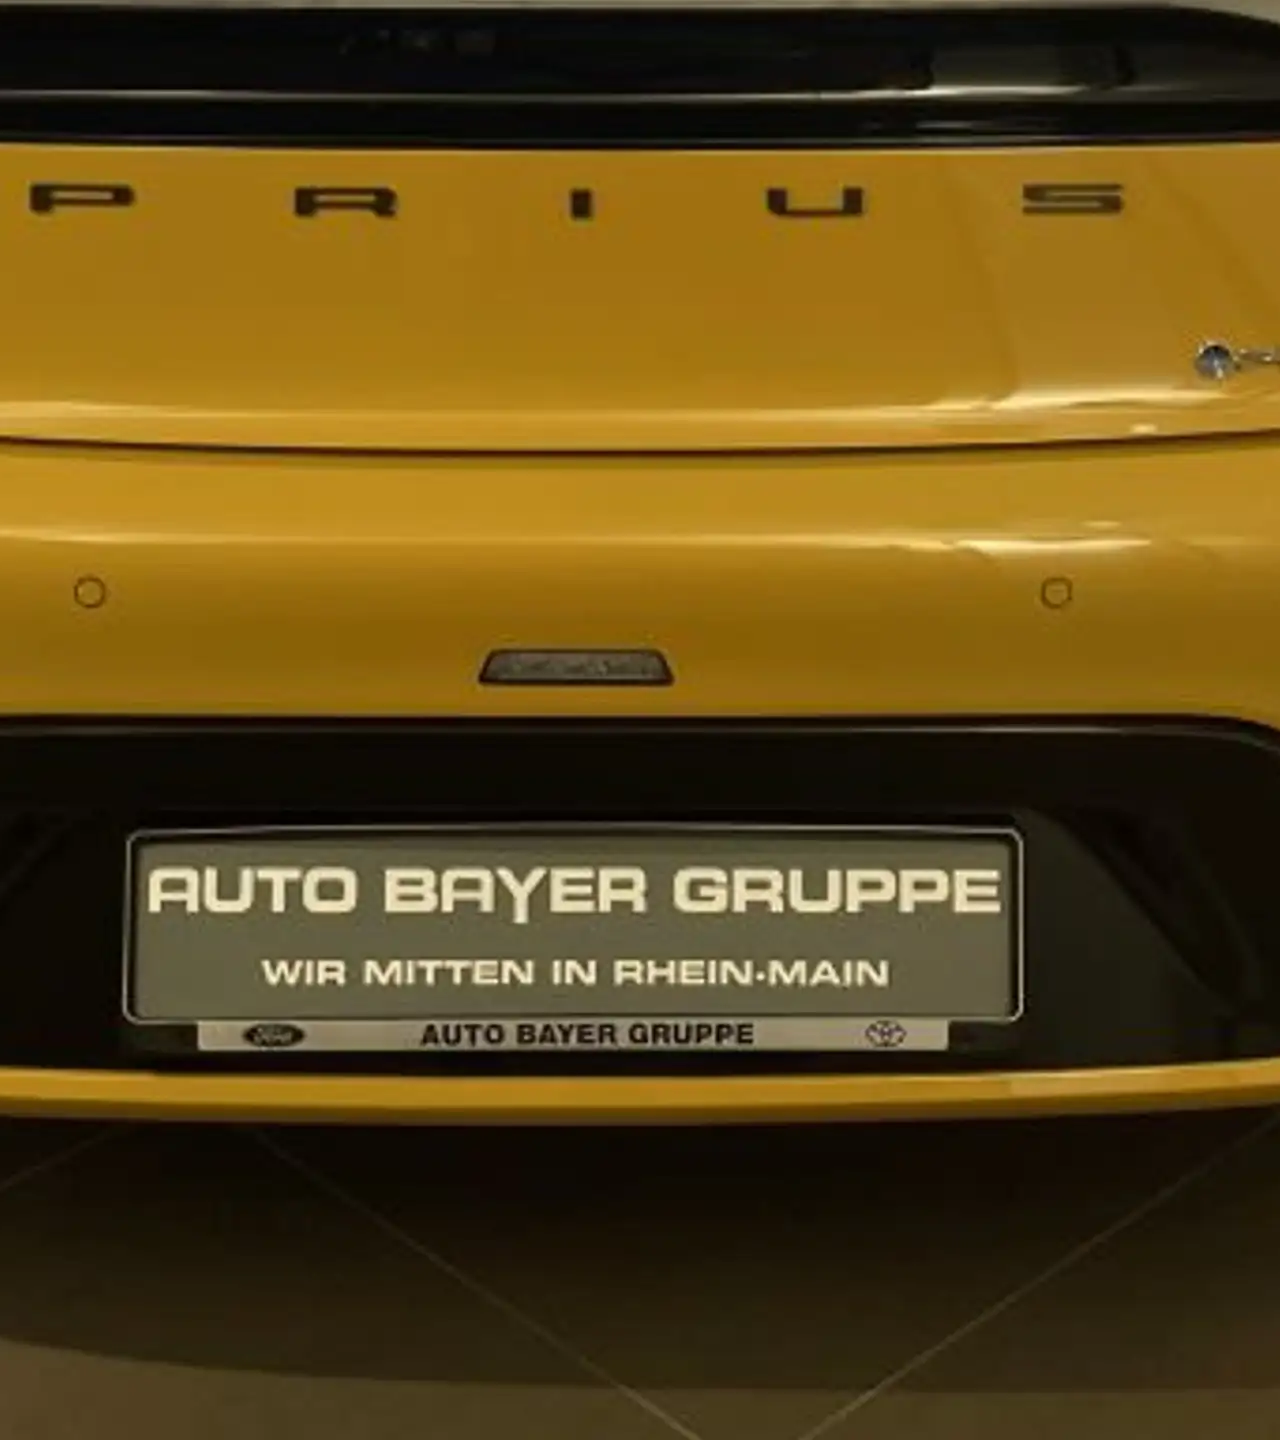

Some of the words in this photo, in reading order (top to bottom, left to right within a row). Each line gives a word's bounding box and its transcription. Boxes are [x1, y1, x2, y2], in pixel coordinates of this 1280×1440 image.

[28, 182, 1125, 218] PRIUS
[148, 866, 359, 914] AUTO
[384, 866, 649, 924] BAYER
[673, 866, 1002, 914] GRUPPE
[261, 959, 347, 986] WIR
[363, 959, 535, 986] MITTEN
[551, 959, 597, 986] IN
[420, 1023, 506, 1046] AUTO
[516, 1023, 617, 1045] BAYER
[628, 1023, 754, 1045] GRUPPE
